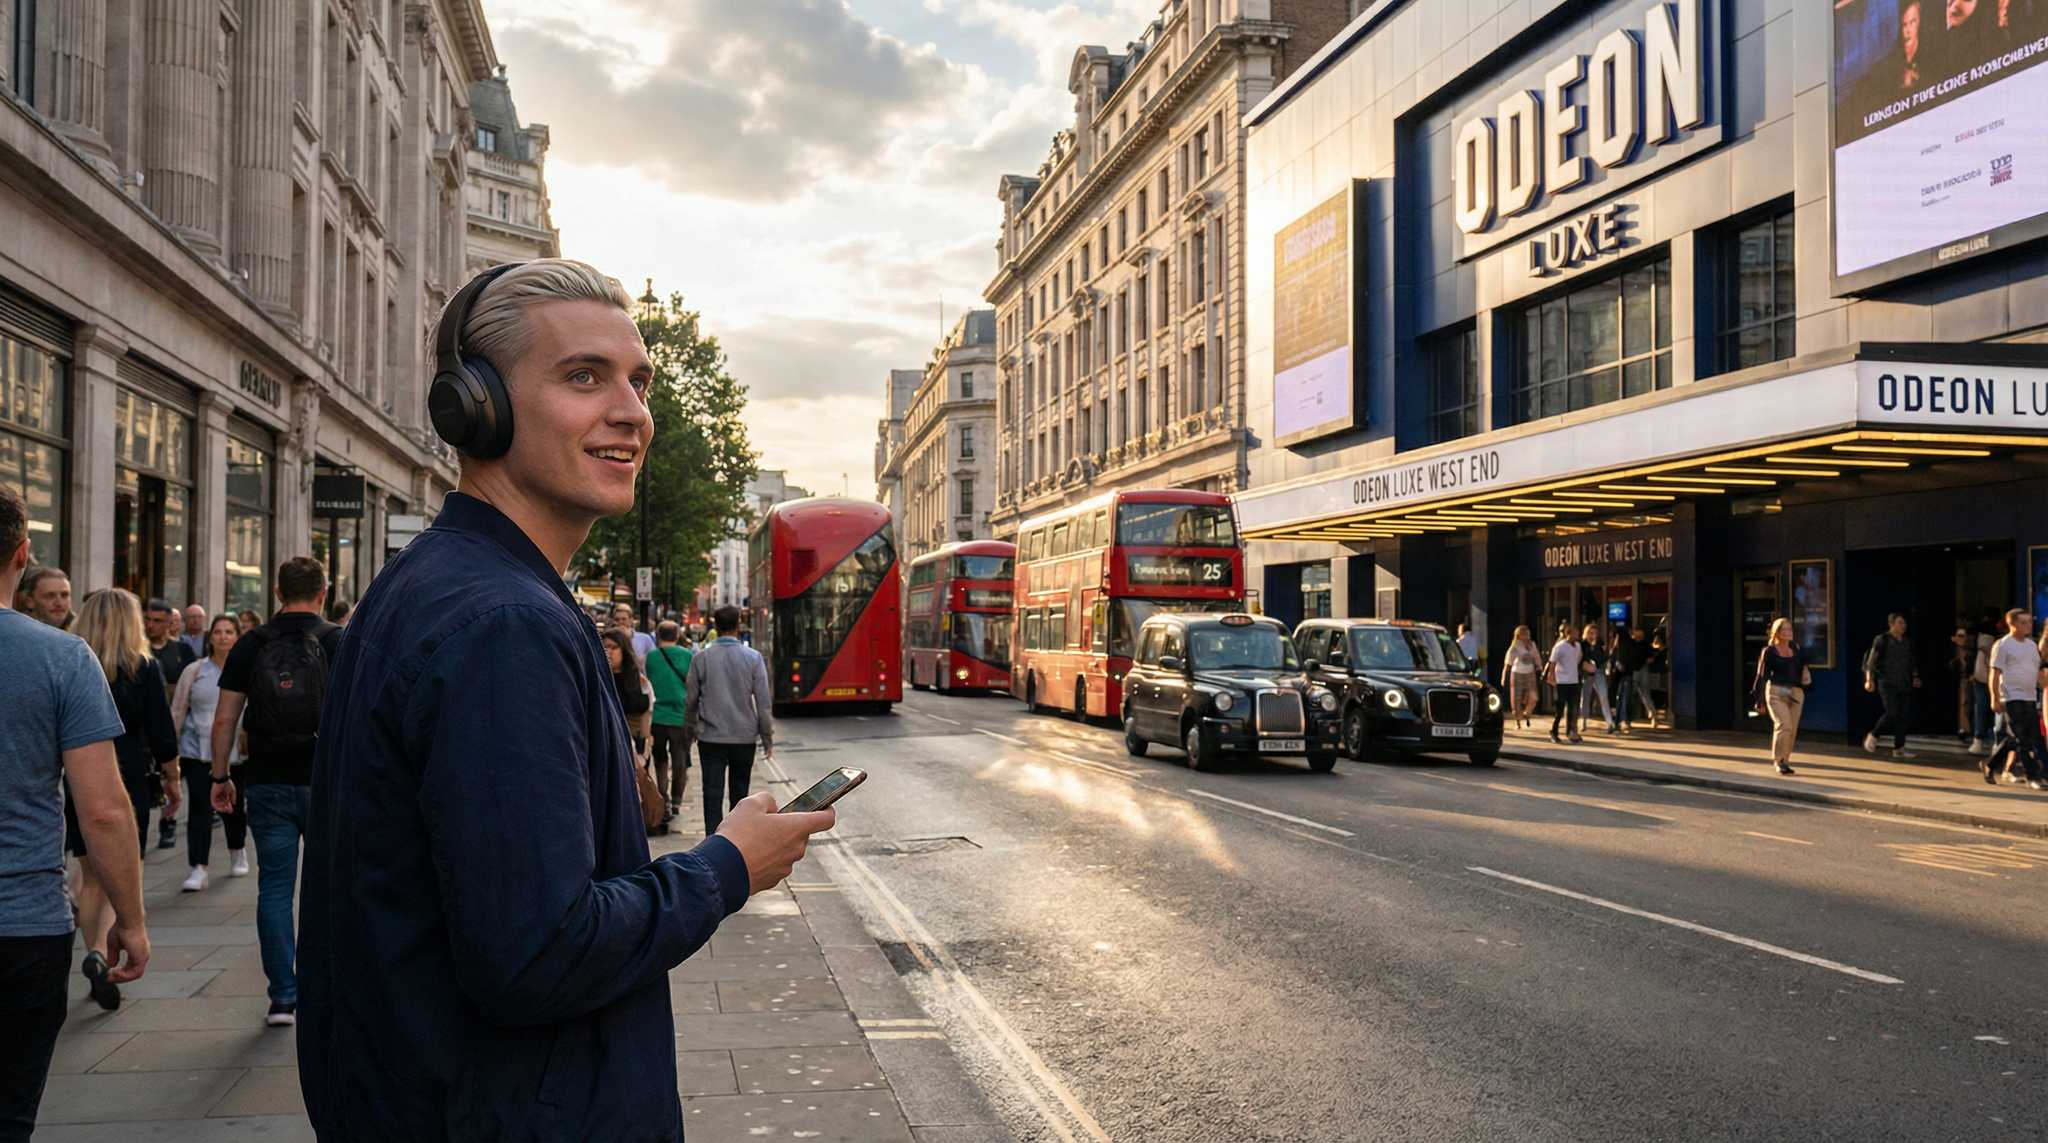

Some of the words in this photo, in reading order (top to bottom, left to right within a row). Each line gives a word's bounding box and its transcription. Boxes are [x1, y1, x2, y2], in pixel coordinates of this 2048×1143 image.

[1455, 0, 1705, 234] ODEON
[1529, 203, 1622, 278] LUXE
[1878, 374, 1994, 415] ODEON
[2012, 380, 2048, 416] LU
[1353, 474, 1389, 504] ODEON
[1394, 467, 1424, 497] LUXE
[1428, 458, 1465, 492] WEST
[1470, 451, 1500, 483] END
[1203, 563, 1222, 580] 25
[1582, 543, 1610, 564] LUXE
[1614, 540, 1645, 562] WEST
[1649, 537, 1673, 559] END
